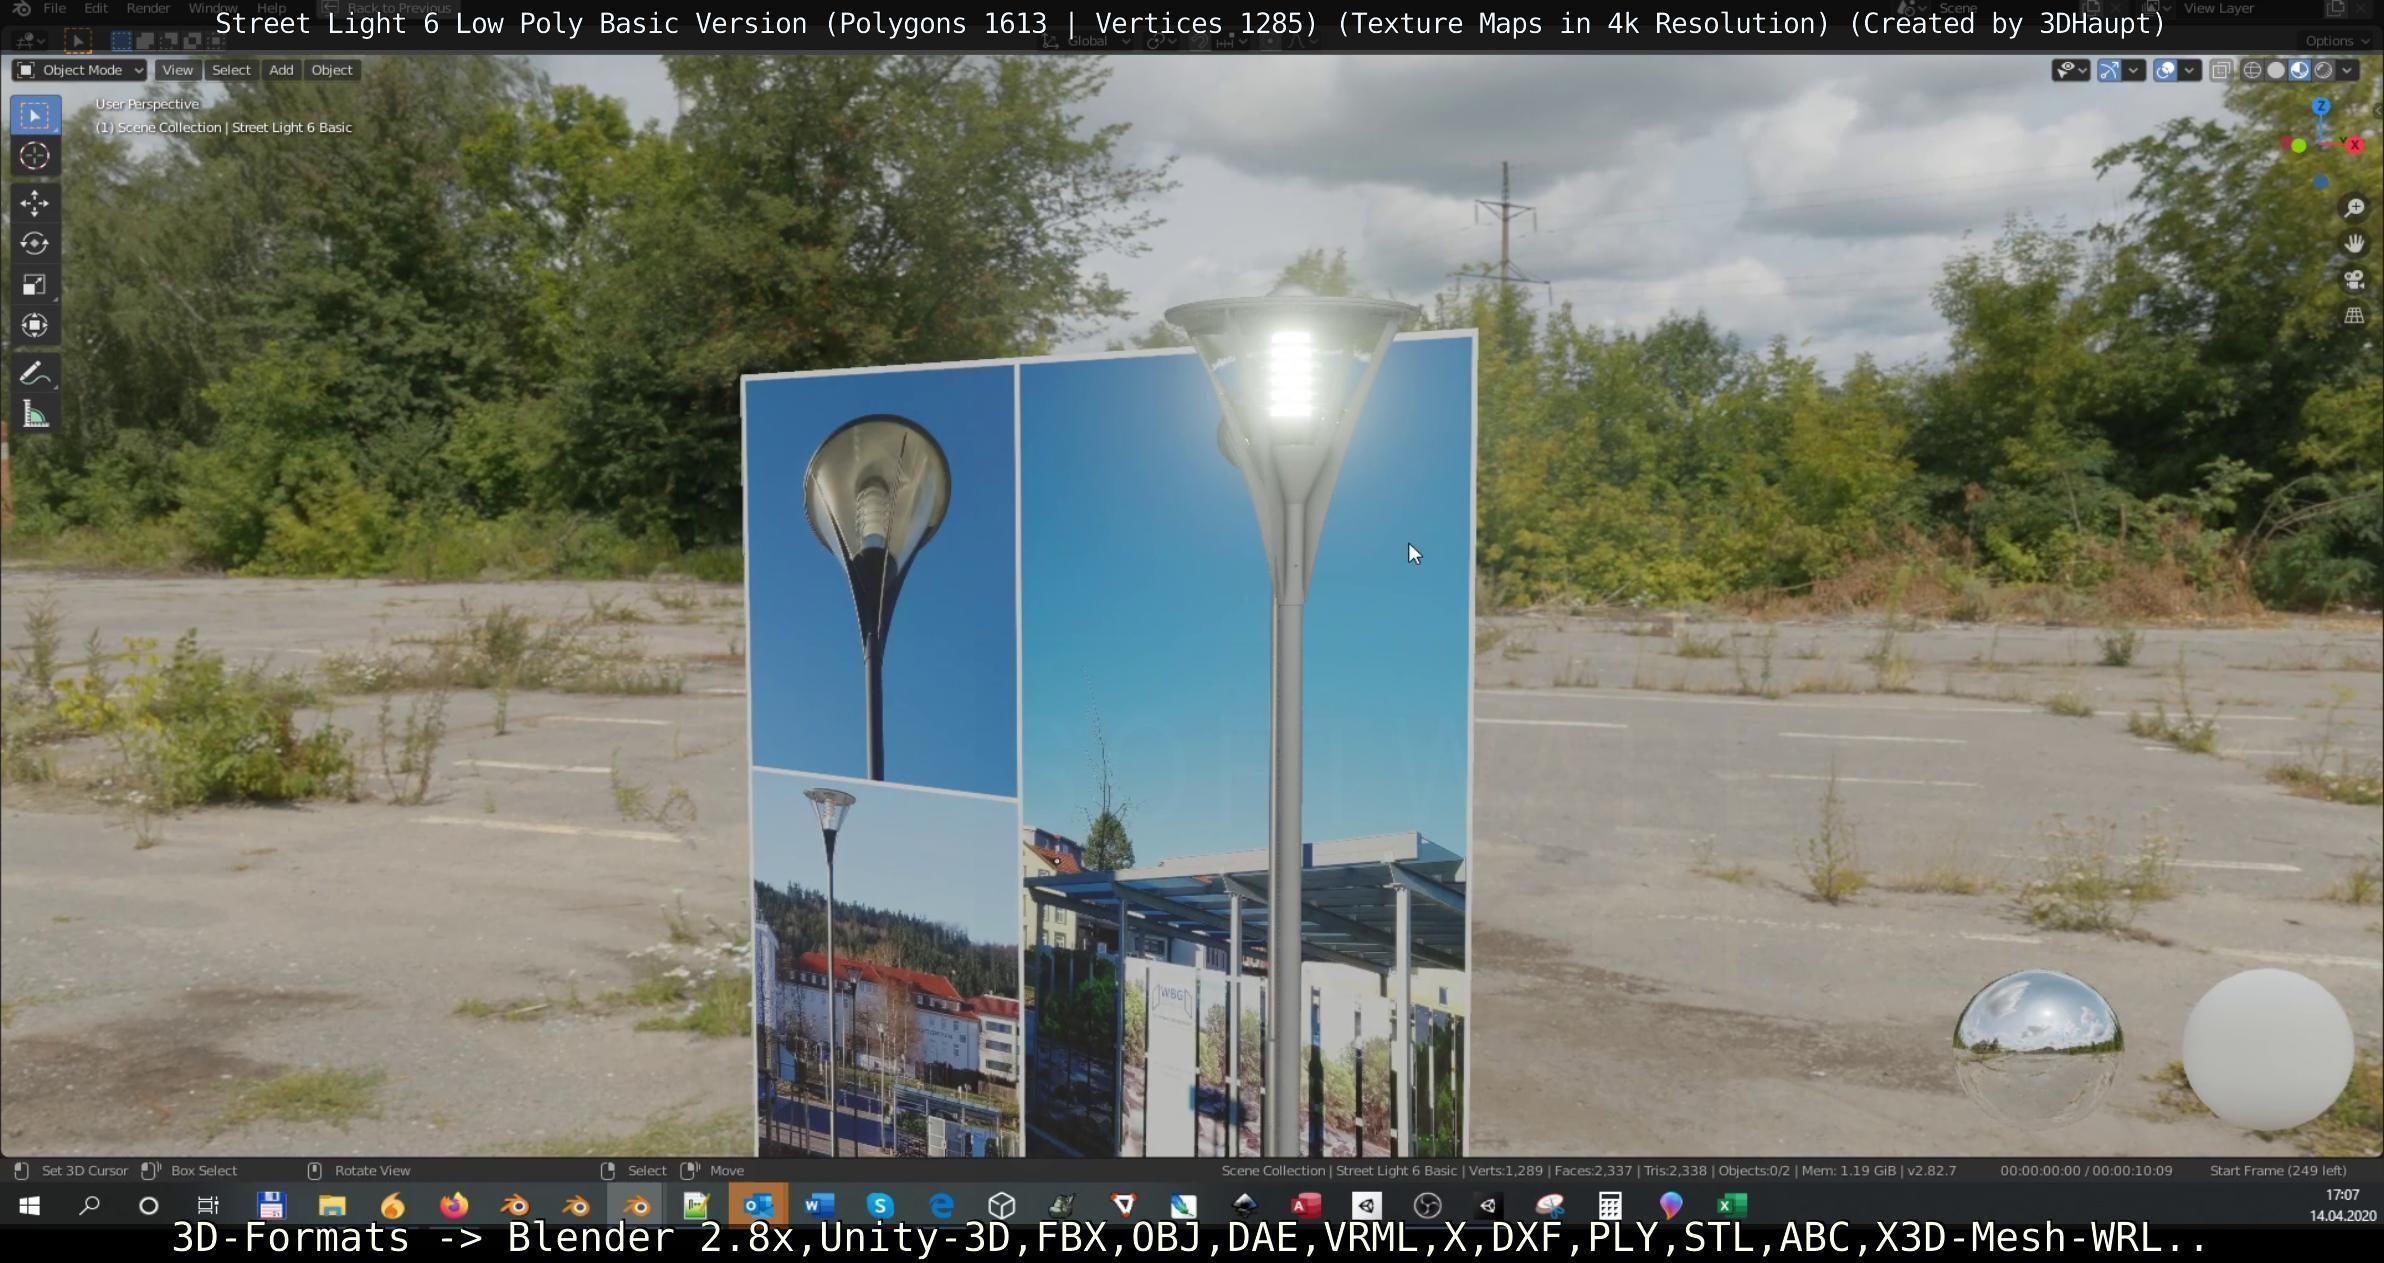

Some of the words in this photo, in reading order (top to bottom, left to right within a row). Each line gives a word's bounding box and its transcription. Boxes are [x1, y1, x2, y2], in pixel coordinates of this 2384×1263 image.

[44, 3, 66, 14] File
[85, 3, 108, 14] Edit
[127, 3, 170, 14] Render
[189, 3, 238, 14] Window
[257, 3, 287, 17] Help
[348, 3, 377, 14] Back
[383, 3, 396, 14] to
[400, 3, 451, 14] Previous
[1940, 3, 1978, 14] Scene
[2185, 3, 2219, 14] View
[2222, 3, 2254, 17] Layer
[1068, 35, 1107, 47] Global
[2307, 34, 2354, 47] Options
[44, 64, 84, 77] Object
[88, 64, 123, 76] Mode
[163, 64, 194, 76] View
[212, 64, 251, 76] Select
[269, 64, 294, 76] Add
[312, 64, 353, 77] Object
[96, 99, 125, 110] User
[128, 98, 200, 113] Perspective
[96, 121, 115, 135] (1)
[118, 122, 155, 134] Scene
[159, 121, 222, 134] Collection
[232, 122, 269, 134] Street
[273, 121, 304, 136] Light
[308, 122, 316, 134] 6
[320, 121, 353, 134] Basic
[42, 1165, 63, 1177] Set
[67, 1165, 85, 1177] 3D
[89, 1165, 129, 1177] Cursor
[171, 1165, 195, 1177] Box
[199, 1165, 238, 1177] Select
[335, 1165, 376, 1177] Rotate
[380, 1165, 411, 1177] View
[628, 1165, 667, 1177] Select
[710, 1165, 745, 1177] Move
[1222, 1165, 1259, 1177] Scene
[1263, 1165, 1326, 1177] Collection
[1336, 1165, 1373, 1177] Street
[1377, 1165, 1409, 1179] Light
[1412, 1165, 1421, 1177] 6
[1424, 1165, 1457, 1177] Basic
[1469, 1165, 1543, 1178] Verts:1,289
[1555, 1165, 1633, 1178] Faces:2,337
[1644, 1165, 1707, 1178] Tris:2,338
[1718, 1165, 1790, 1179] Objects:0/2
[1802, 1165, 1837, 1177] Mem:
[1841, 1165, 1870, 1177] 1.19
[1873, 1165, 1897, 1177] GiB
[1907, 1165, 1957, 1177] v2.82.7
[2000, 1165, 2081, 1177] 00:00:00:00
[2093, 1165, 2173, 1177] 00:00:10:09
[2210, 1165, 2240, 1177] Start
[2244, 1165, 2284, 1177] Frame
[2287, 1165, 2318, 1178] (249
[2322, 1164, 2347, 1178] left)
[2326, 1188, 2360, 1201] 17:07
[2310, 1209, 2378, 1222] 14.04.2020
